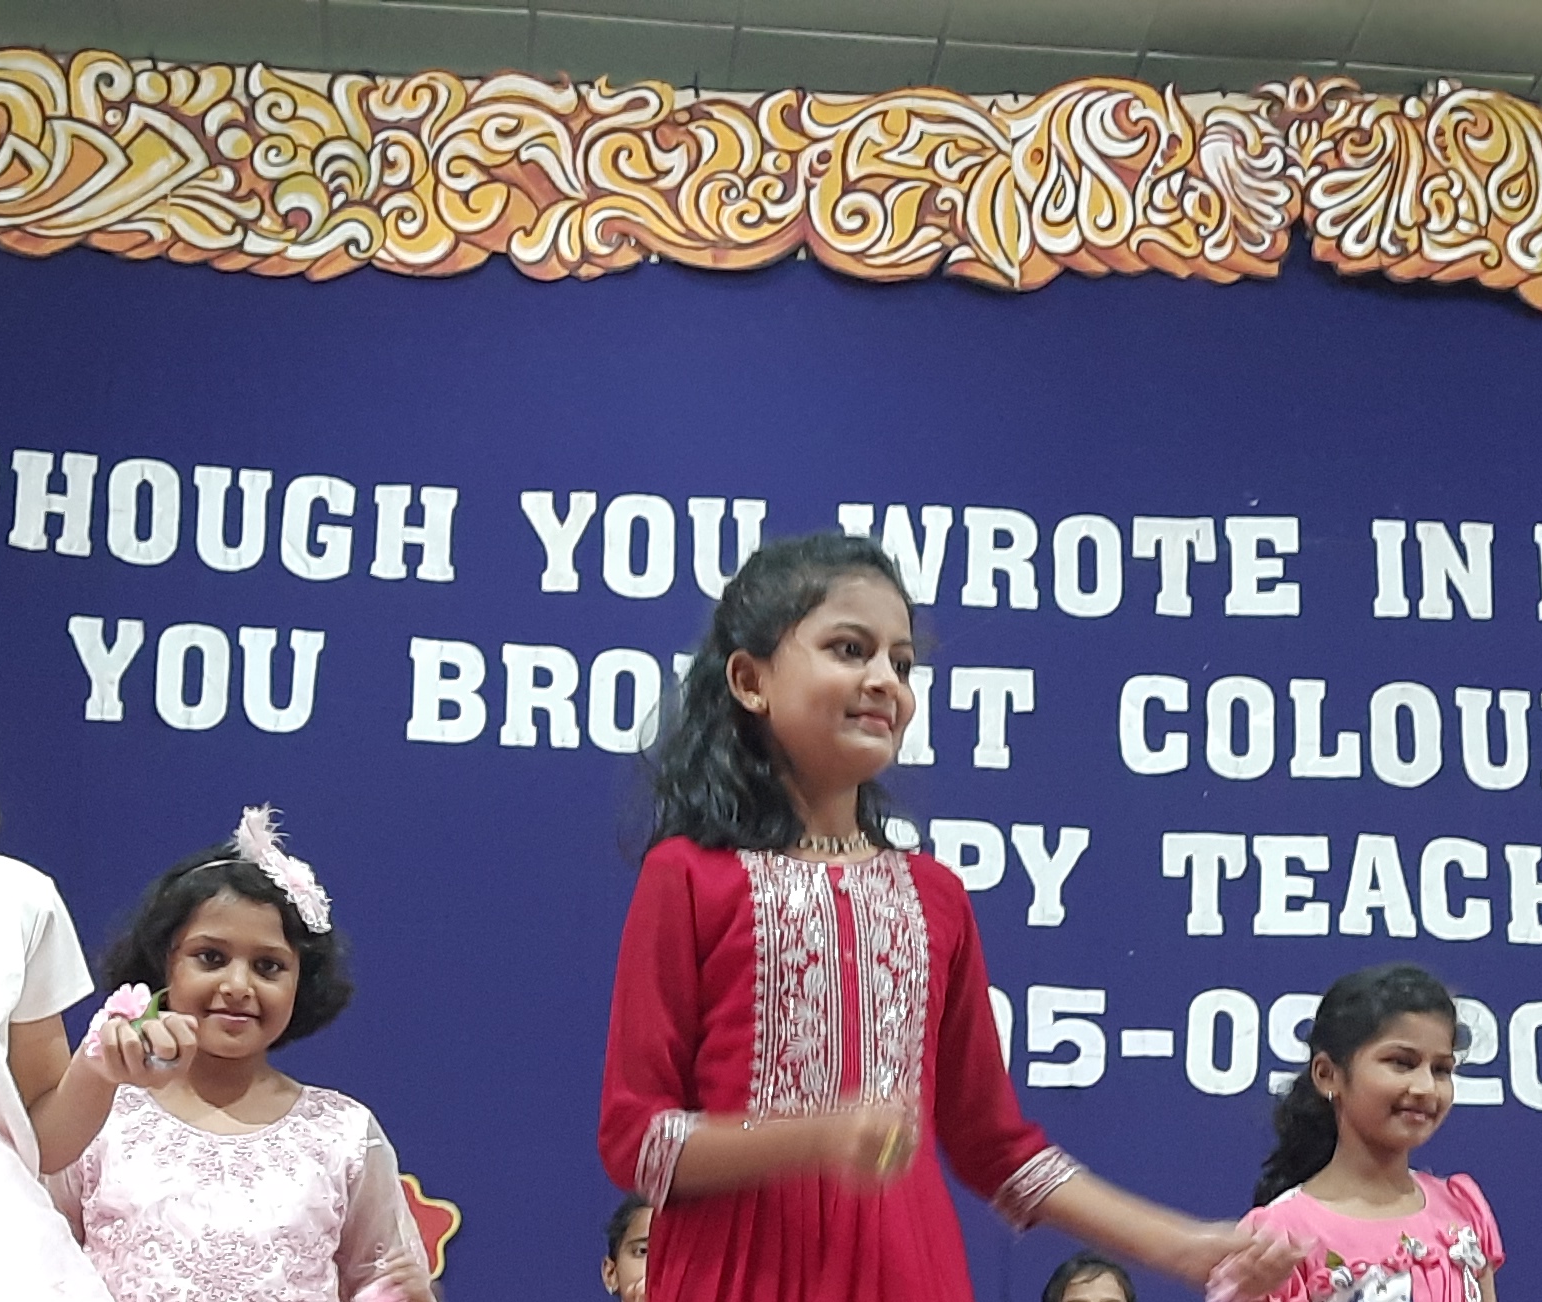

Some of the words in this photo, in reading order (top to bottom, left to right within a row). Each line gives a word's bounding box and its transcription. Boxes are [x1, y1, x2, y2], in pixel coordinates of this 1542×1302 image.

[519, 489, 768, 602] YOU
[836, 502, 1301, 620] WROTE
[1370, 517, 1495, 622] IN
[66, 614, 327, 736] YOU
[405, 635, 1036, 771] BROT
